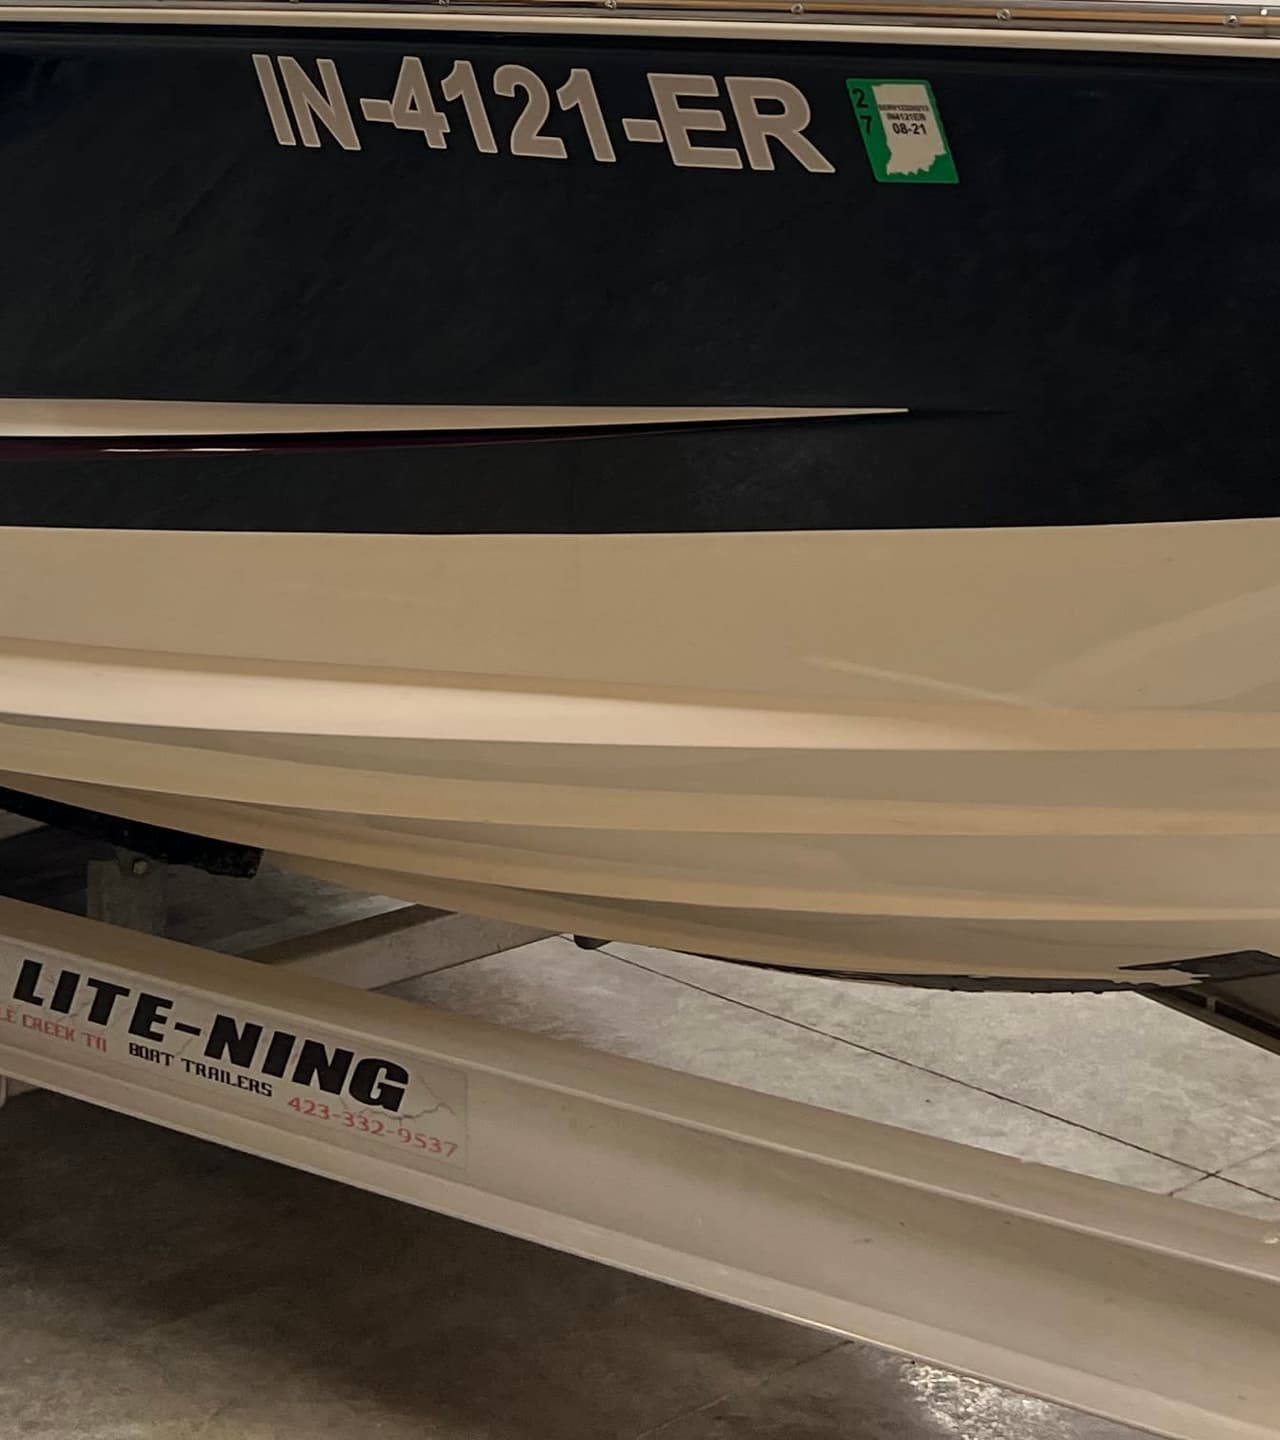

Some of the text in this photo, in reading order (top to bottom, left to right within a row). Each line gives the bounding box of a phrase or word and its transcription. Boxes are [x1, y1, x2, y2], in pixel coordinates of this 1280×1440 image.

[251, 54, 836, 173] IN-4121-ER
[12, 958, 410, 1112] LITE-NING
[22, 1013, 76, 1043] CREEK
[81, 1031, 108, 1053] TN
[128, 1041, 273, 1098] BOAT TRAILERS
[287, 1096, 459, 1158] 423-332-9537
